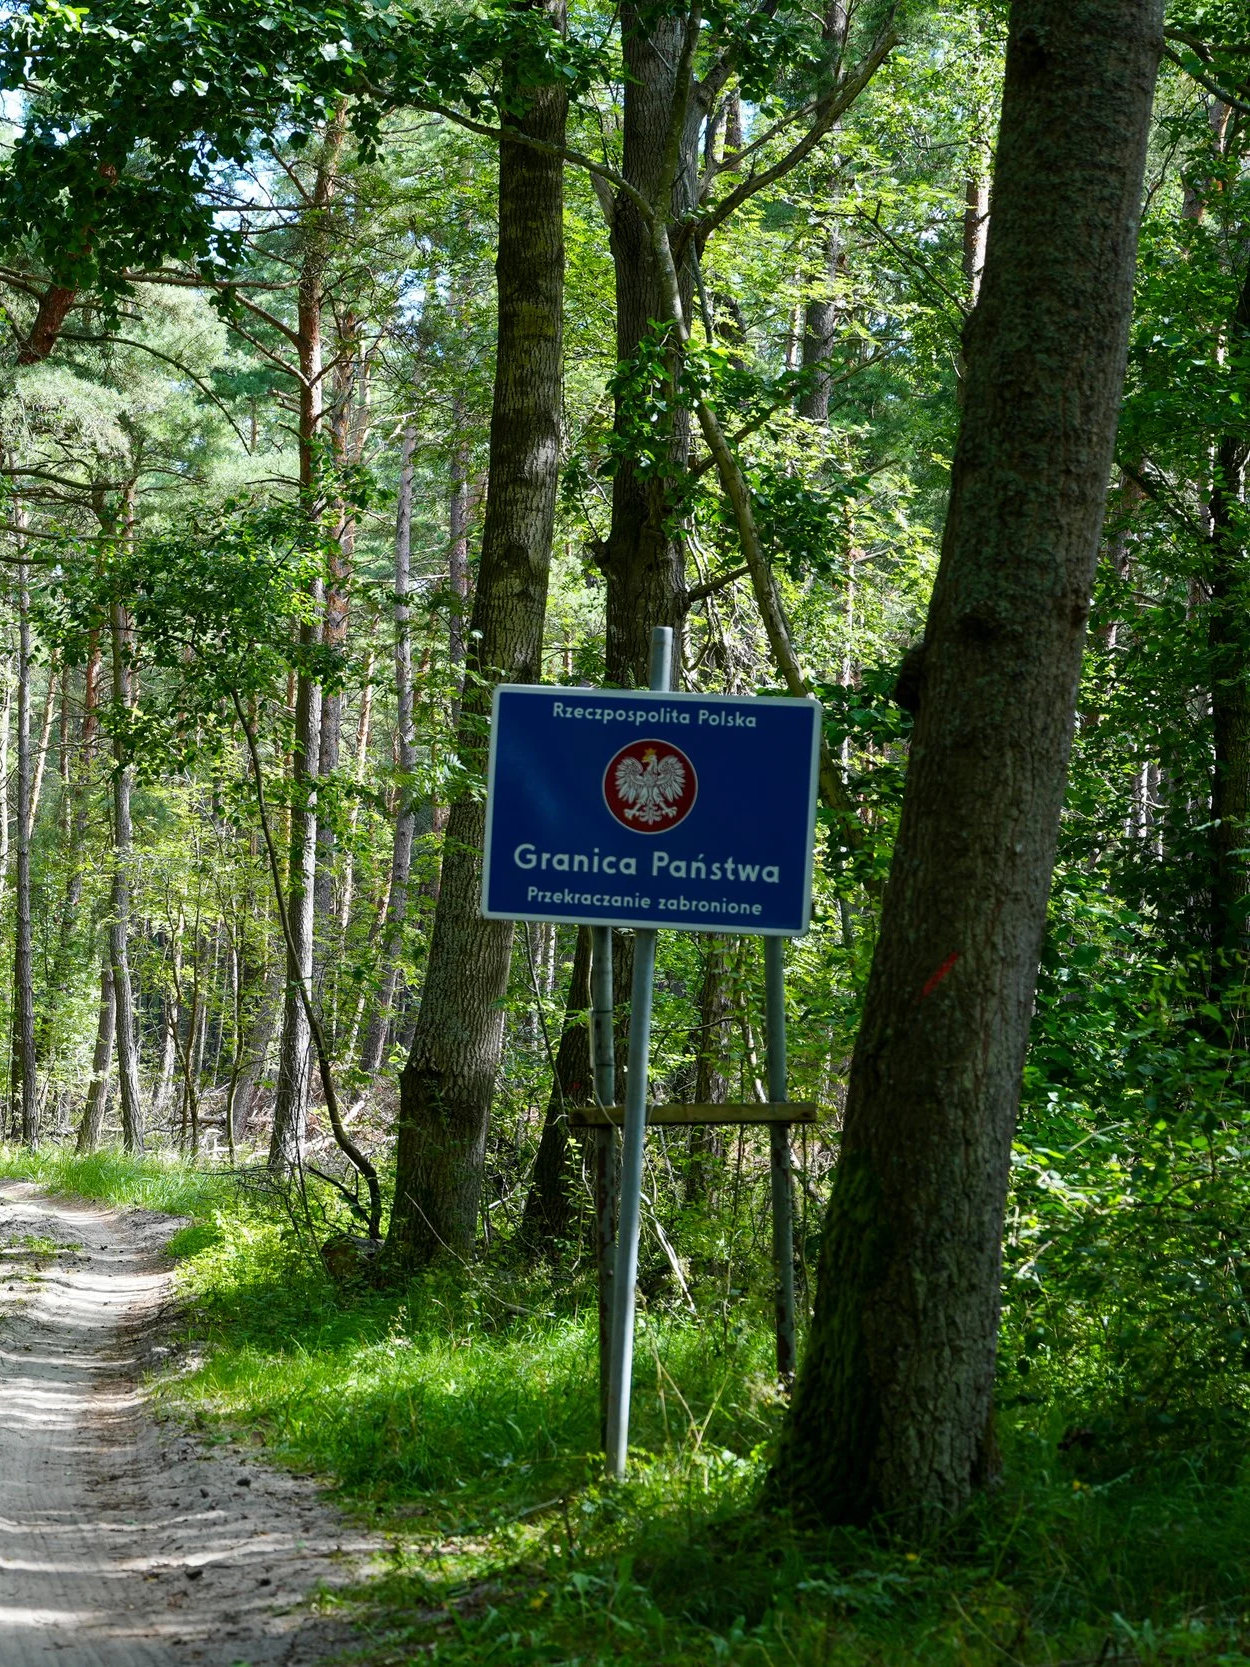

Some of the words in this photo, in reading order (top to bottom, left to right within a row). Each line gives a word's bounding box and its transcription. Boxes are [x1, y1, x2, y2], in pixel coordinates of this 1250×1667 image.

[553, 702, 690, 726] Rzeczpospolita
[698, 709, 757, 728] Polska
[513, 843, 638, 875] Granica
[652, 851, 780, 884] Państwa
[527, 887, 651, 909] Przekraczanie
[658, 896, 762, 915] zabronione
